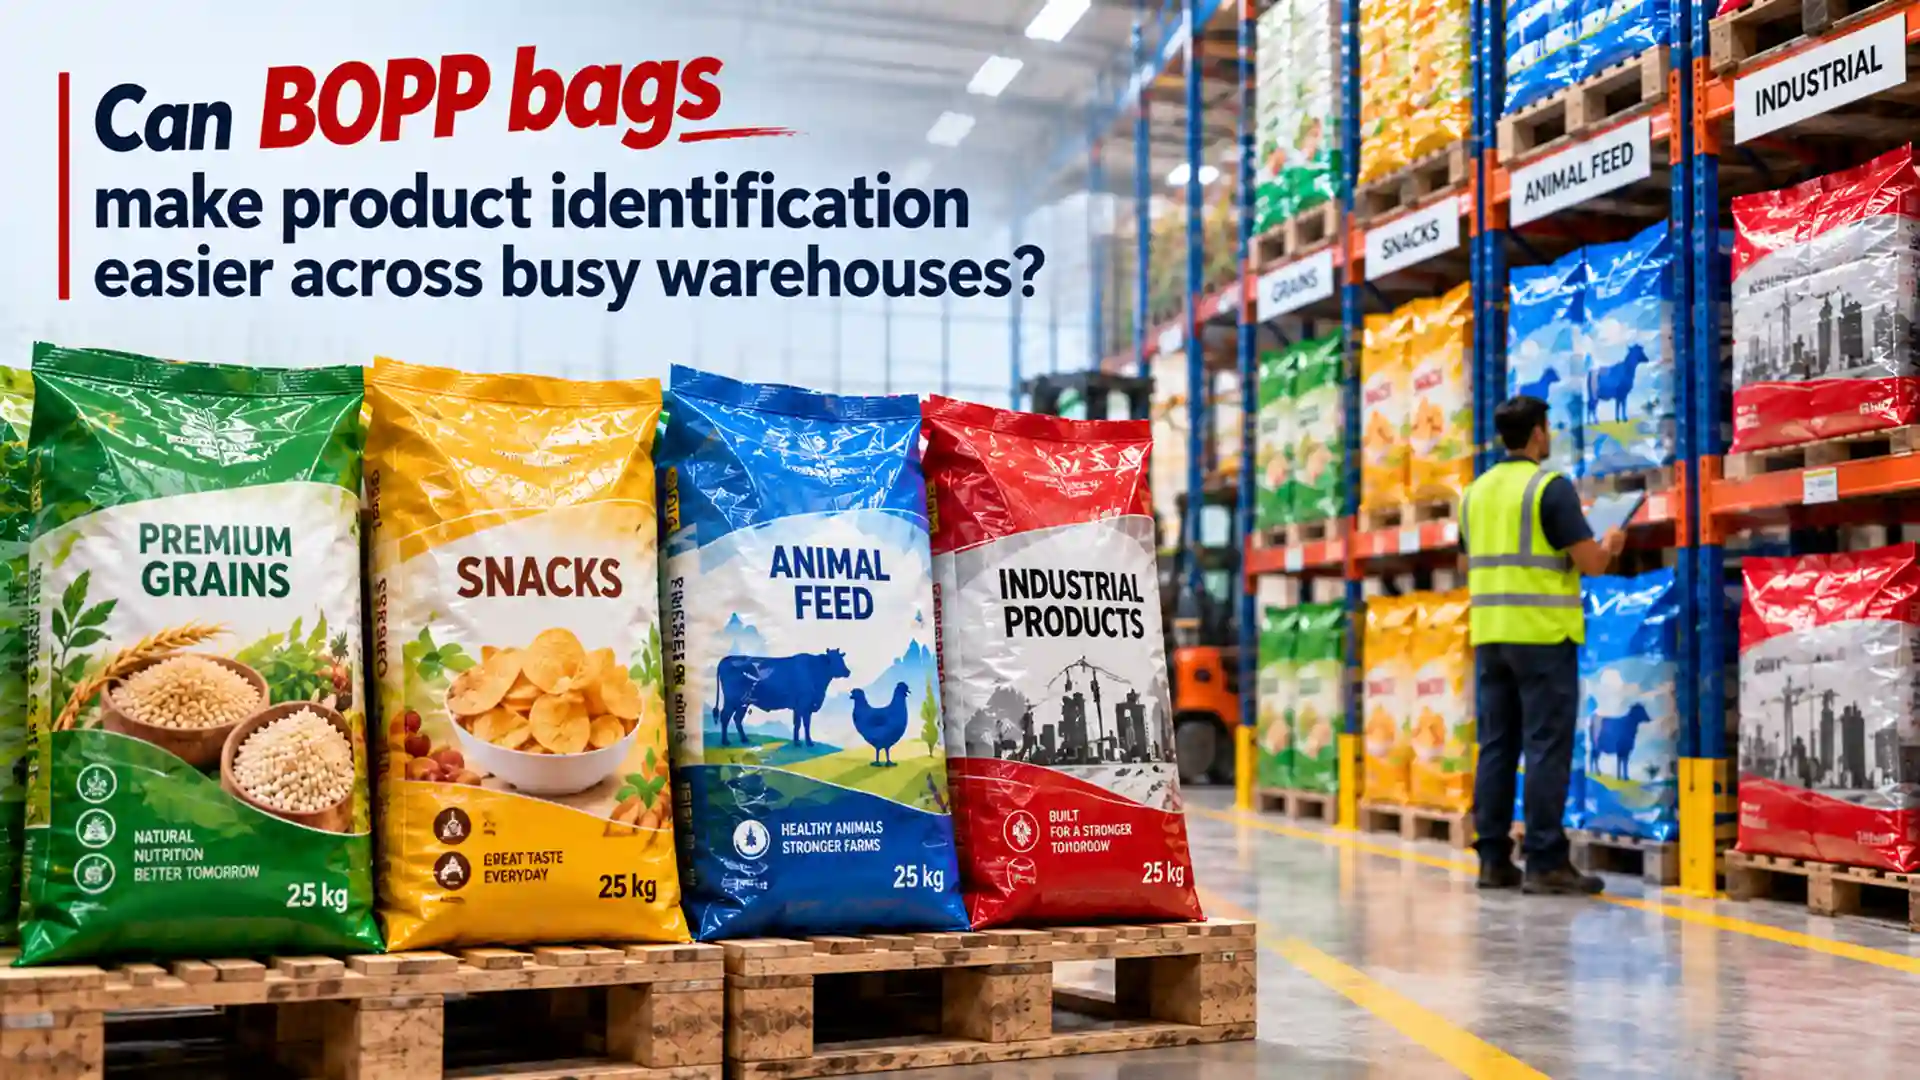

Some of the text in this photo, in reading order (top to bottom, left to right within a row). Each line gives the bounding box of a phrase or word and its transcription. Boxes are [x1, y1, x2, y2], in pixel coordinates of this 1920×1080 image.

[1756, 45, 1883, 116] INDUSTRIAL
[1524, 141, 1634, 205] ANIMAL FEED
[1381, 218, 1440, 260] SNACKS
[139, 523, 292, 557] PREMIUM
[457, 556, 623, 599] SNACKS
[770, 545, 890, 581] ANIMAL
[141, 561, 291, 598] GRAINS
[999, 569, 1144, 602] INDUSTRIAL
[794, 585, 874, 620] FEED
[1003, 605, 1145, 639] PRODUCTS
[781, 820, 883, 836] HEALTHY ANIMALS
[1049, 809, 1080, 822] BUILT
[134, 829, 194, 844] NATURAL
[782, 838, 881, 854] STRONGER FARMS
[1050, 825, 1070, 838] FOR
[1073, 825, 1081, 837] A
[527, 850, 563, 864] TASTE
[134, 866, 182, 882] BETTER
[484, 867, 549, 884] EVERYDAY
[598, 872, 657, 904] 25 kg
[893, 864, 944, 893] 25 kg
[1142, 860, 1184, 887] 25 kg
[286, 881, 348, 912] 25 kg
